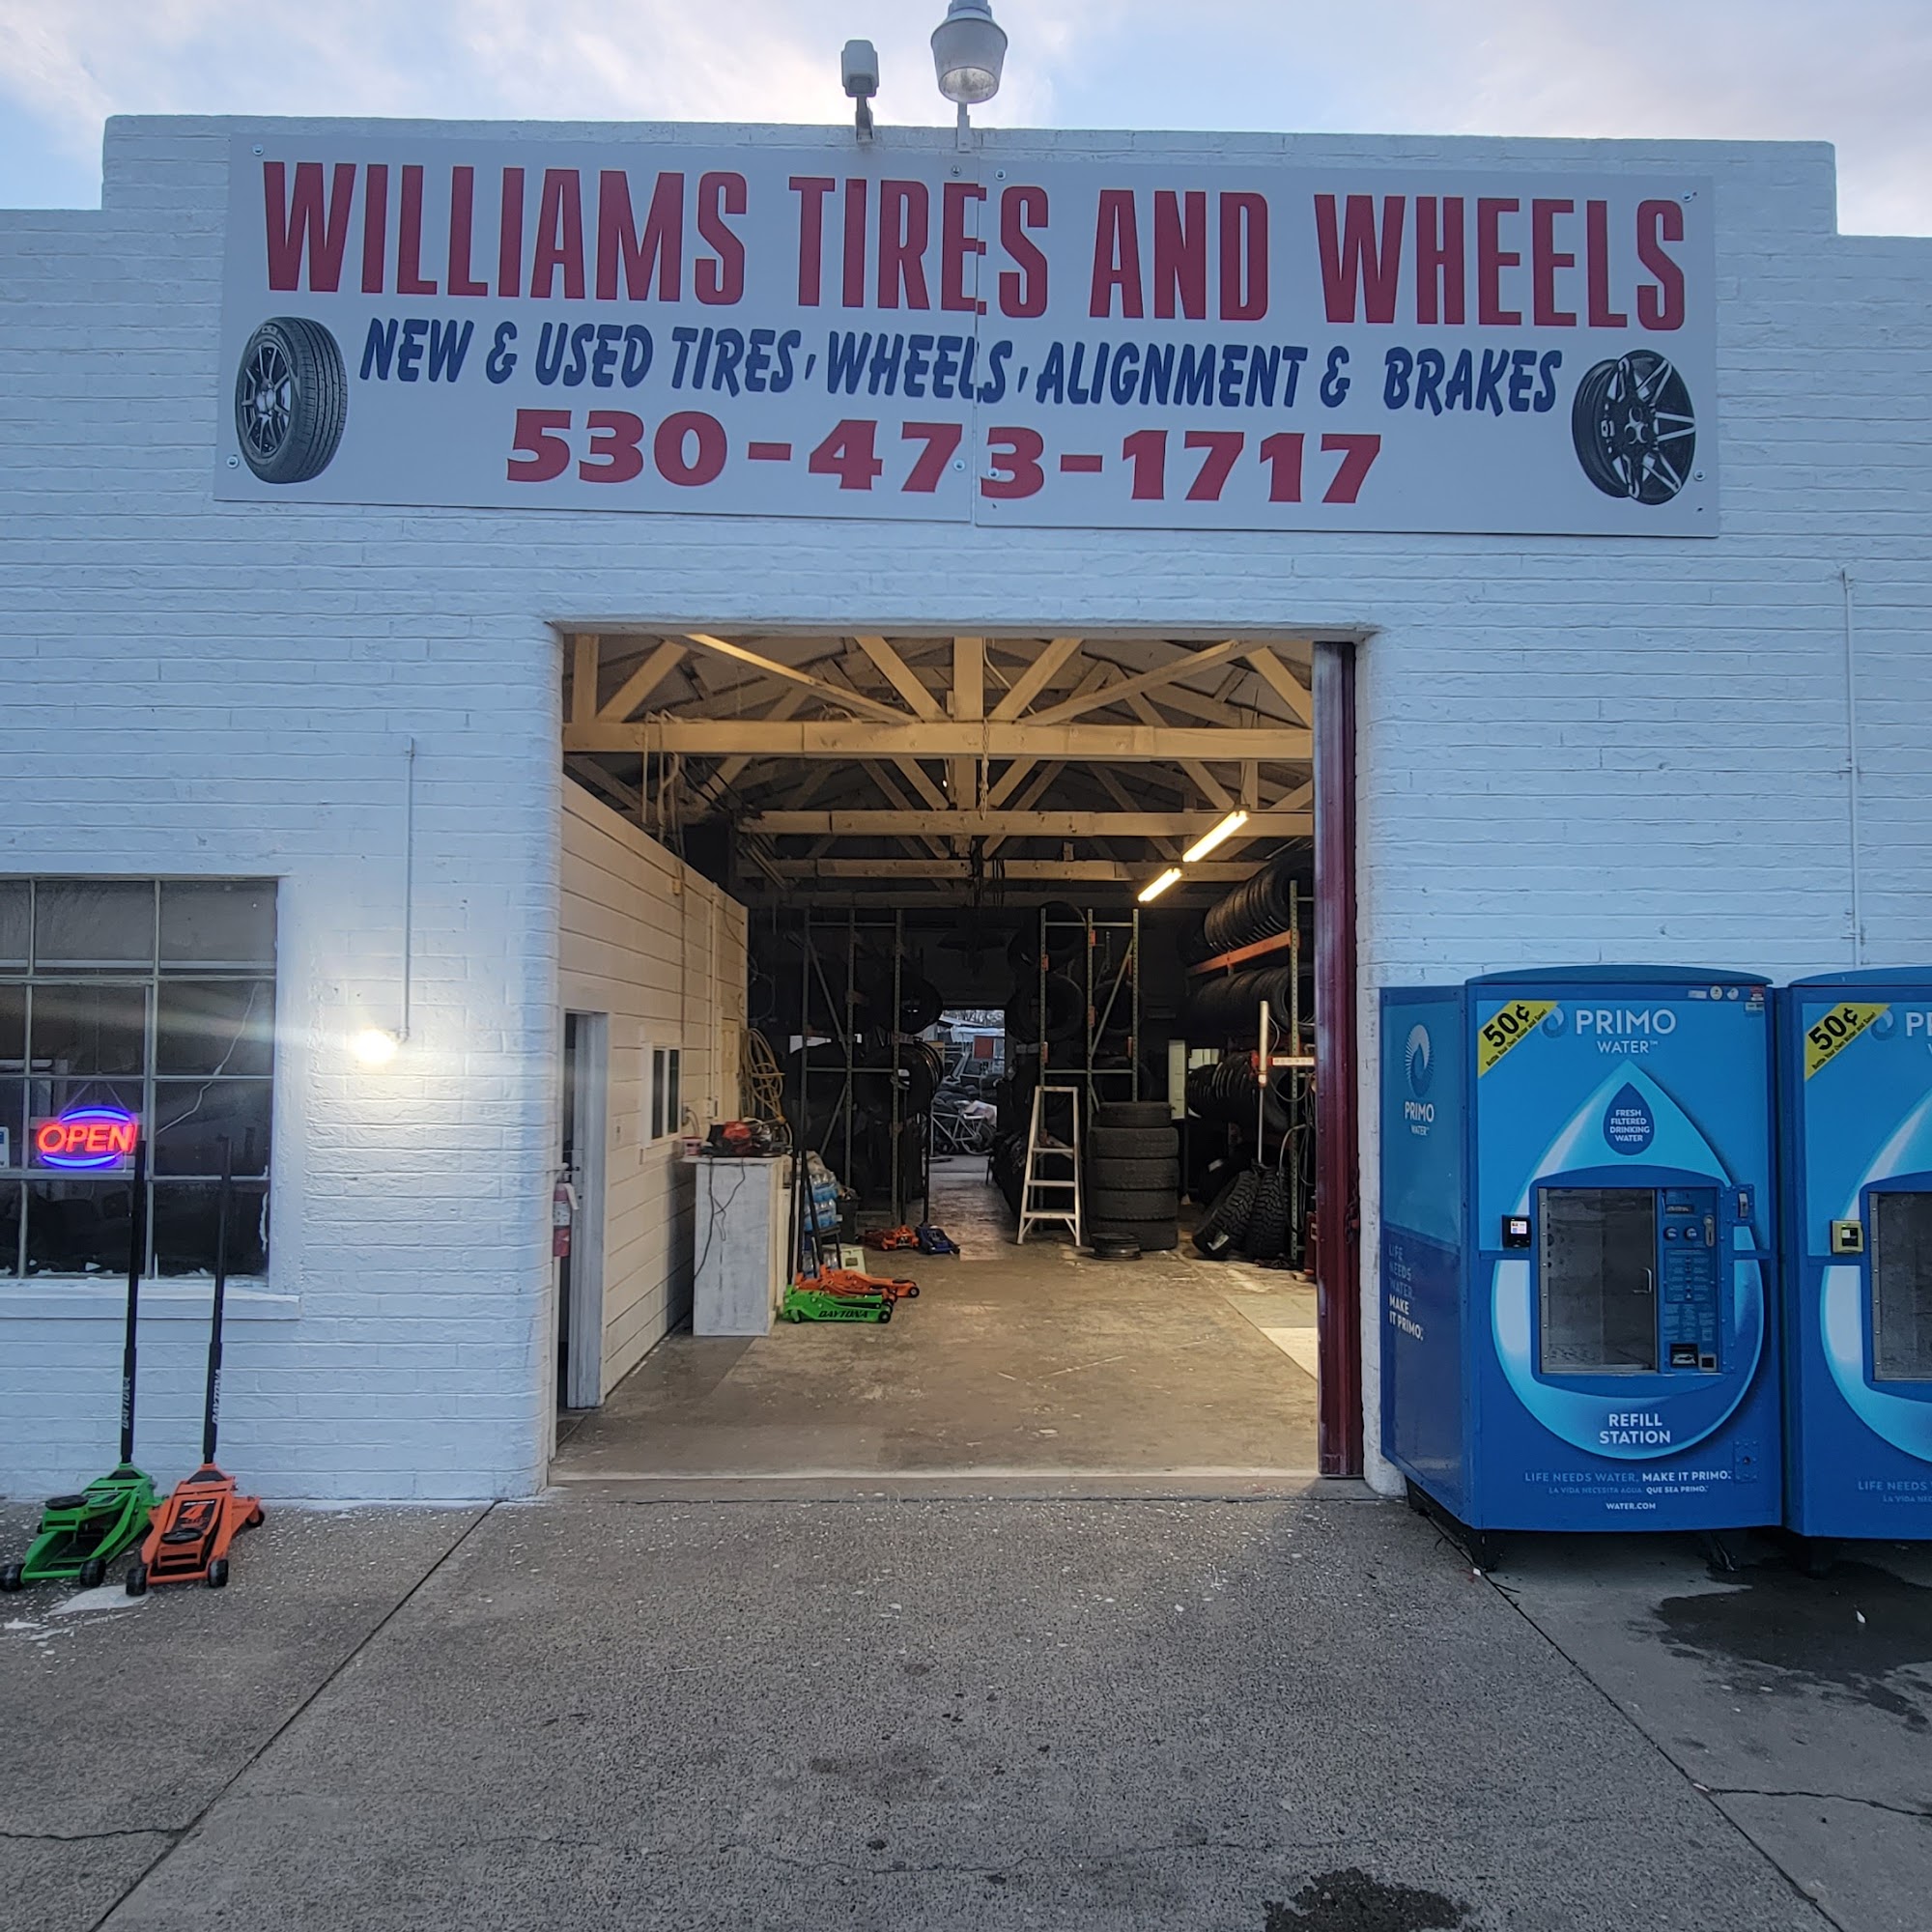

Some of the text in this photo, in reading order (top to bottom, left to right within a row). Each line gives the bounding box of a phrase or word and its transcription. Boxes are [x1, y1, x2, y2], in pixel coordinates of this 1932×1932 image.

[263, 161, 1685, 331] WILLIAMS TIRES AND WHEELS
[360, 318, 475, 384] NEW
[486, 322, 516, 384] &
[535, 323, 653, 388] USED
[1037, 342, 1308, 409] ALIGNMENT
[1321, 346, 1350, 408] &
[1384, 347, 1562, 416] BRAKES
[506, 409, 1380, 503] 530-473-1717
[1483, 1004, 1529, 1047] 50¢
[1576, 1009, 1676, 1035] PRIMO
[1808, 1008, 1858, 1050] 50¢
[1405, 1101, 1435, 1122] PRIMO
[38, 1123, 134, 1152] OPEN
[818, 1310, 868, 1319] DAYTONA
[1389, 1293, 1409, 1315] MAKE
[1389, 1311, 1397, 1325] IT
[1608, 1413, 1662, 1427] REFILL
[1599, 1431, 1671, 1444] STATION
[1525, 1472, 1548, 1482] LIFE
[1553, 1472, 1592, 1482] NEEDS
[1642, 1472, 1675, 1482] MAKE
[1678, 1471, 1689, 1481] IT
[1858, 1481, 1884, 1491] LIFE
[1887, 1481, 1928, 1491] NEEDS
[1646, 1486, 1662, 1494] QUE
